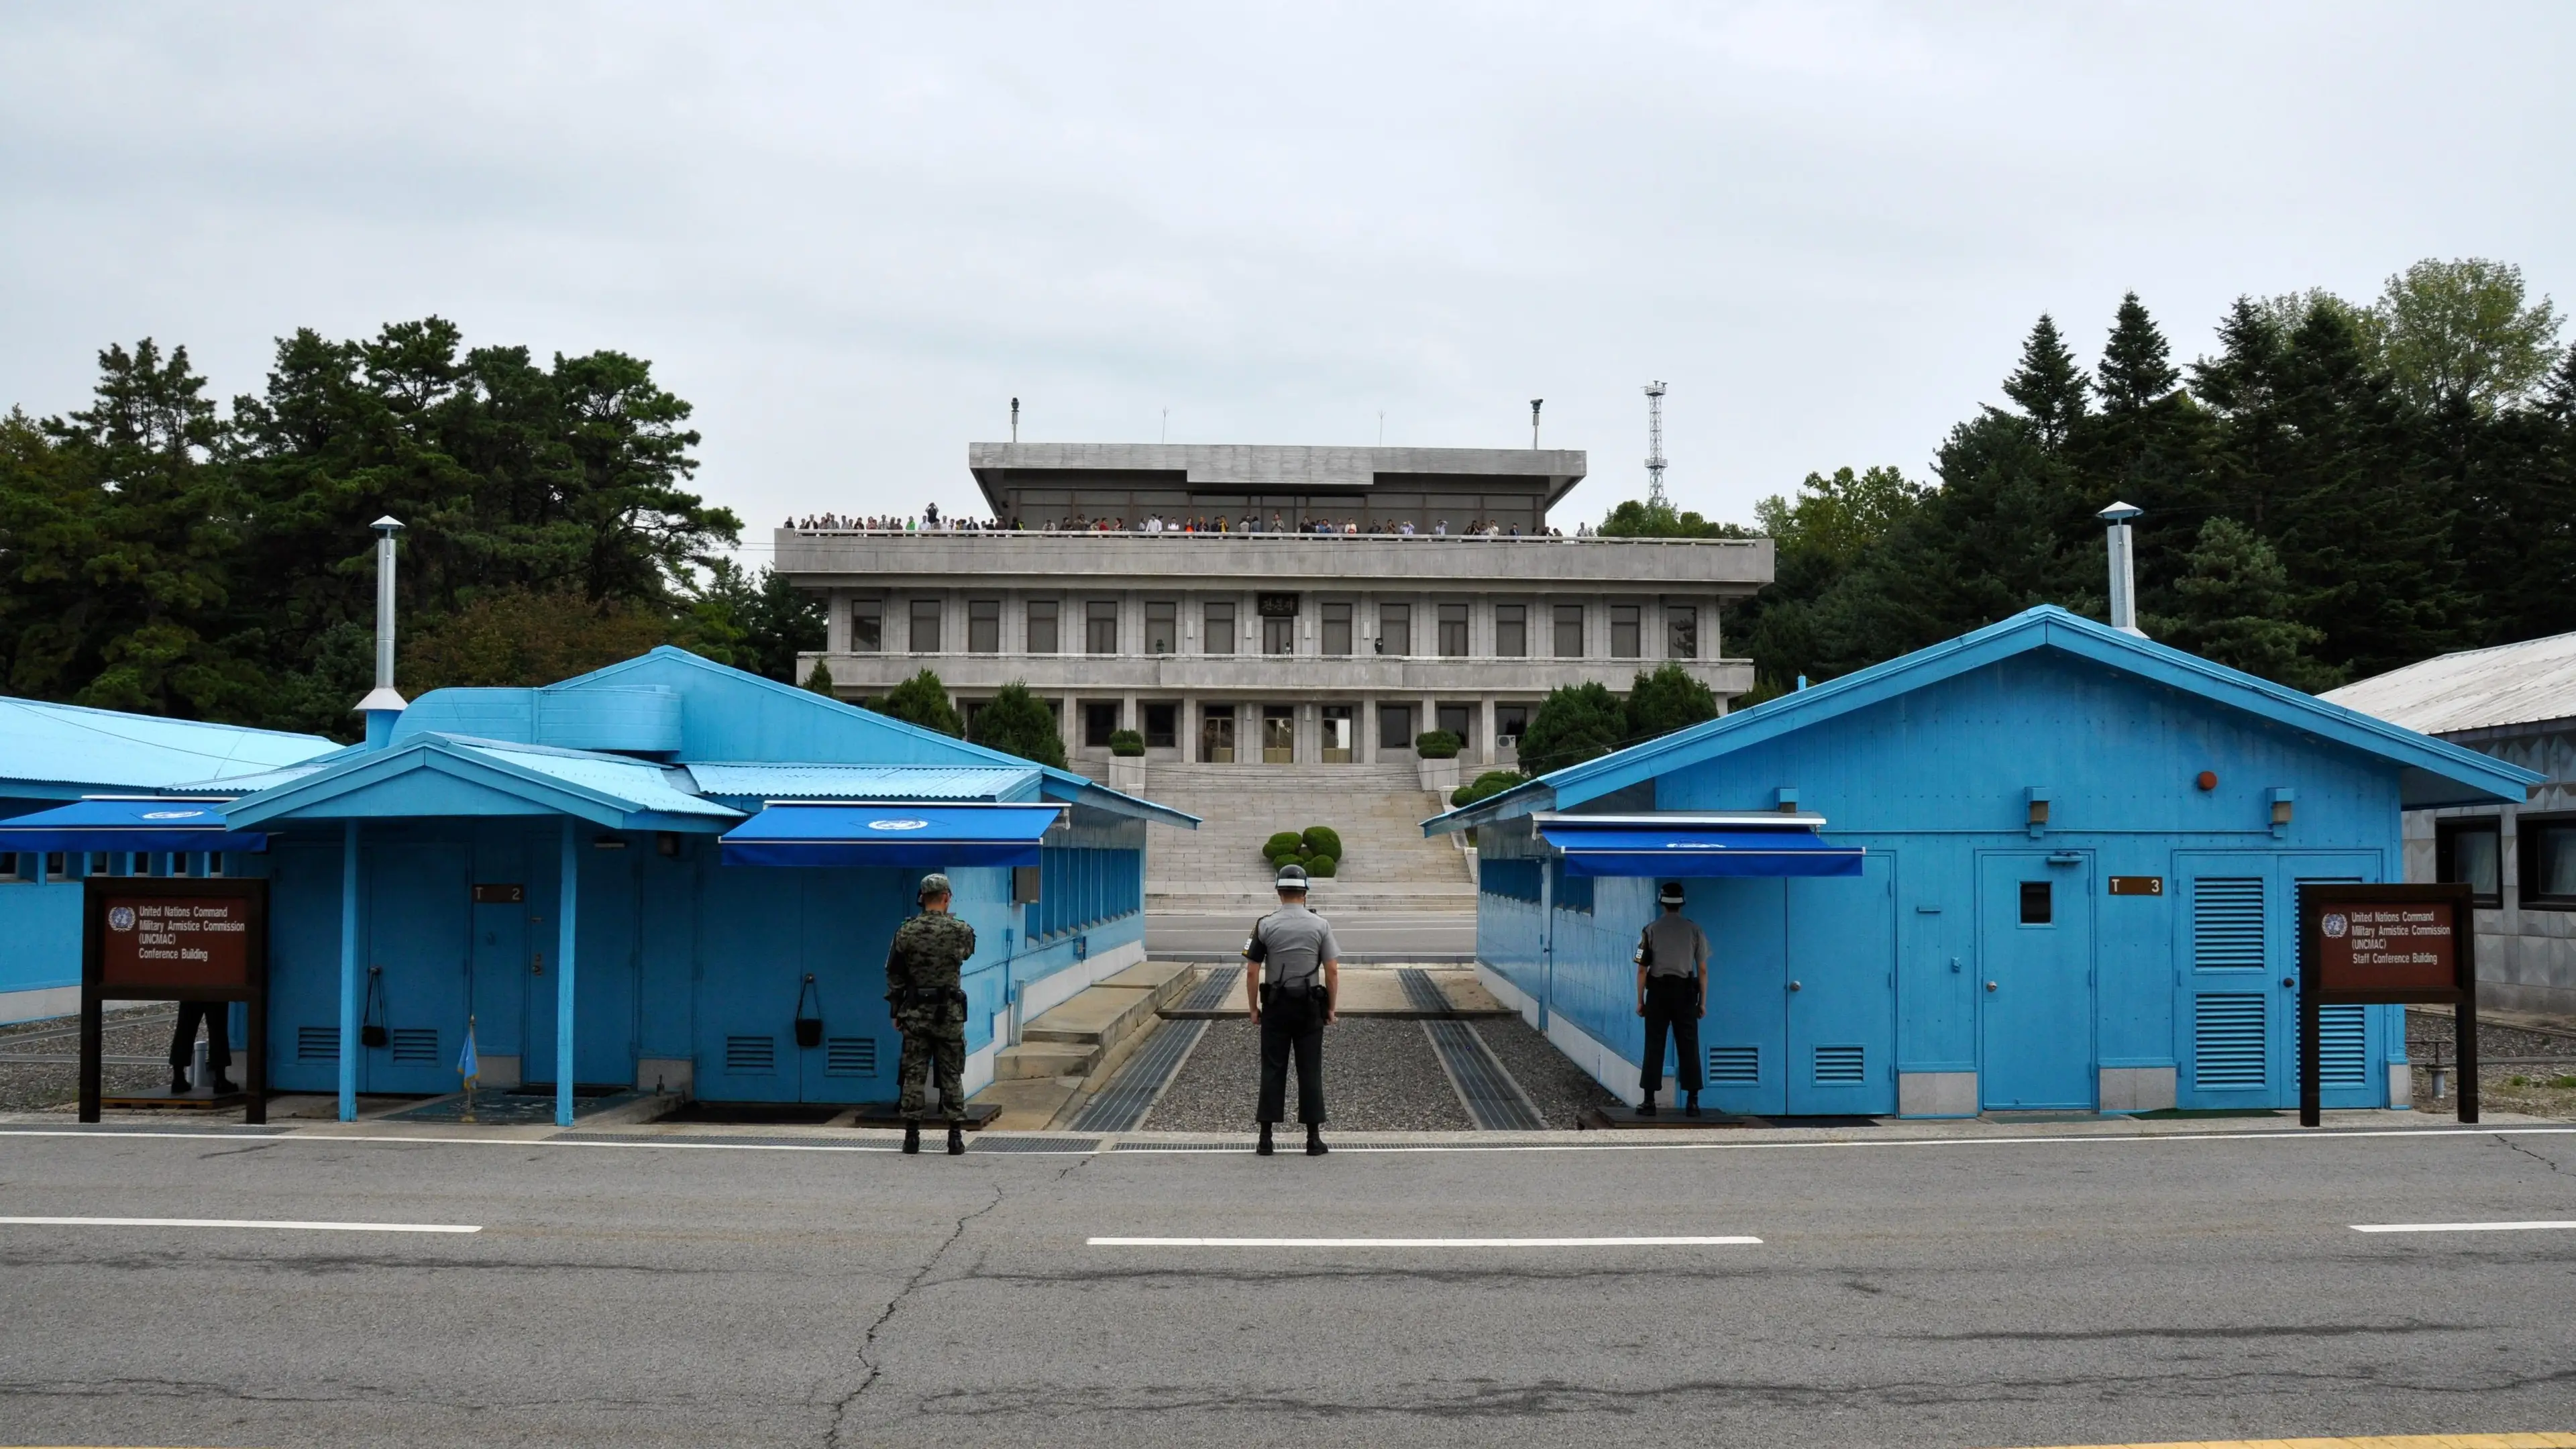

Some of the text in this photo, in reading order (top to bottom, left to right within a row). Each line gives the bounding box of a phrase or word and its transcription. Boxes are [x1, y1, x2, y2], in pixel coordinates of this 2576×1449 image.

[2111, 879, 2159, 893] T 3
[475, 887, 521, 900] T 2
[139, 906, 228, 918] United Nations Command
[2351, 910, 2434, 922] United Nations Command
[139, 920, 245, 933] Military Armistice Commission
[2351, 924, 2451, 938] Military Armistice Commission
[138, 933, 176, 945] (UNCMAC)
[2351, 938, 2387, 951] (UNCMAC)
[138, 947, 208, 962] Conference Building
[2353, 952, 2438, 965] Staff Conference Building
